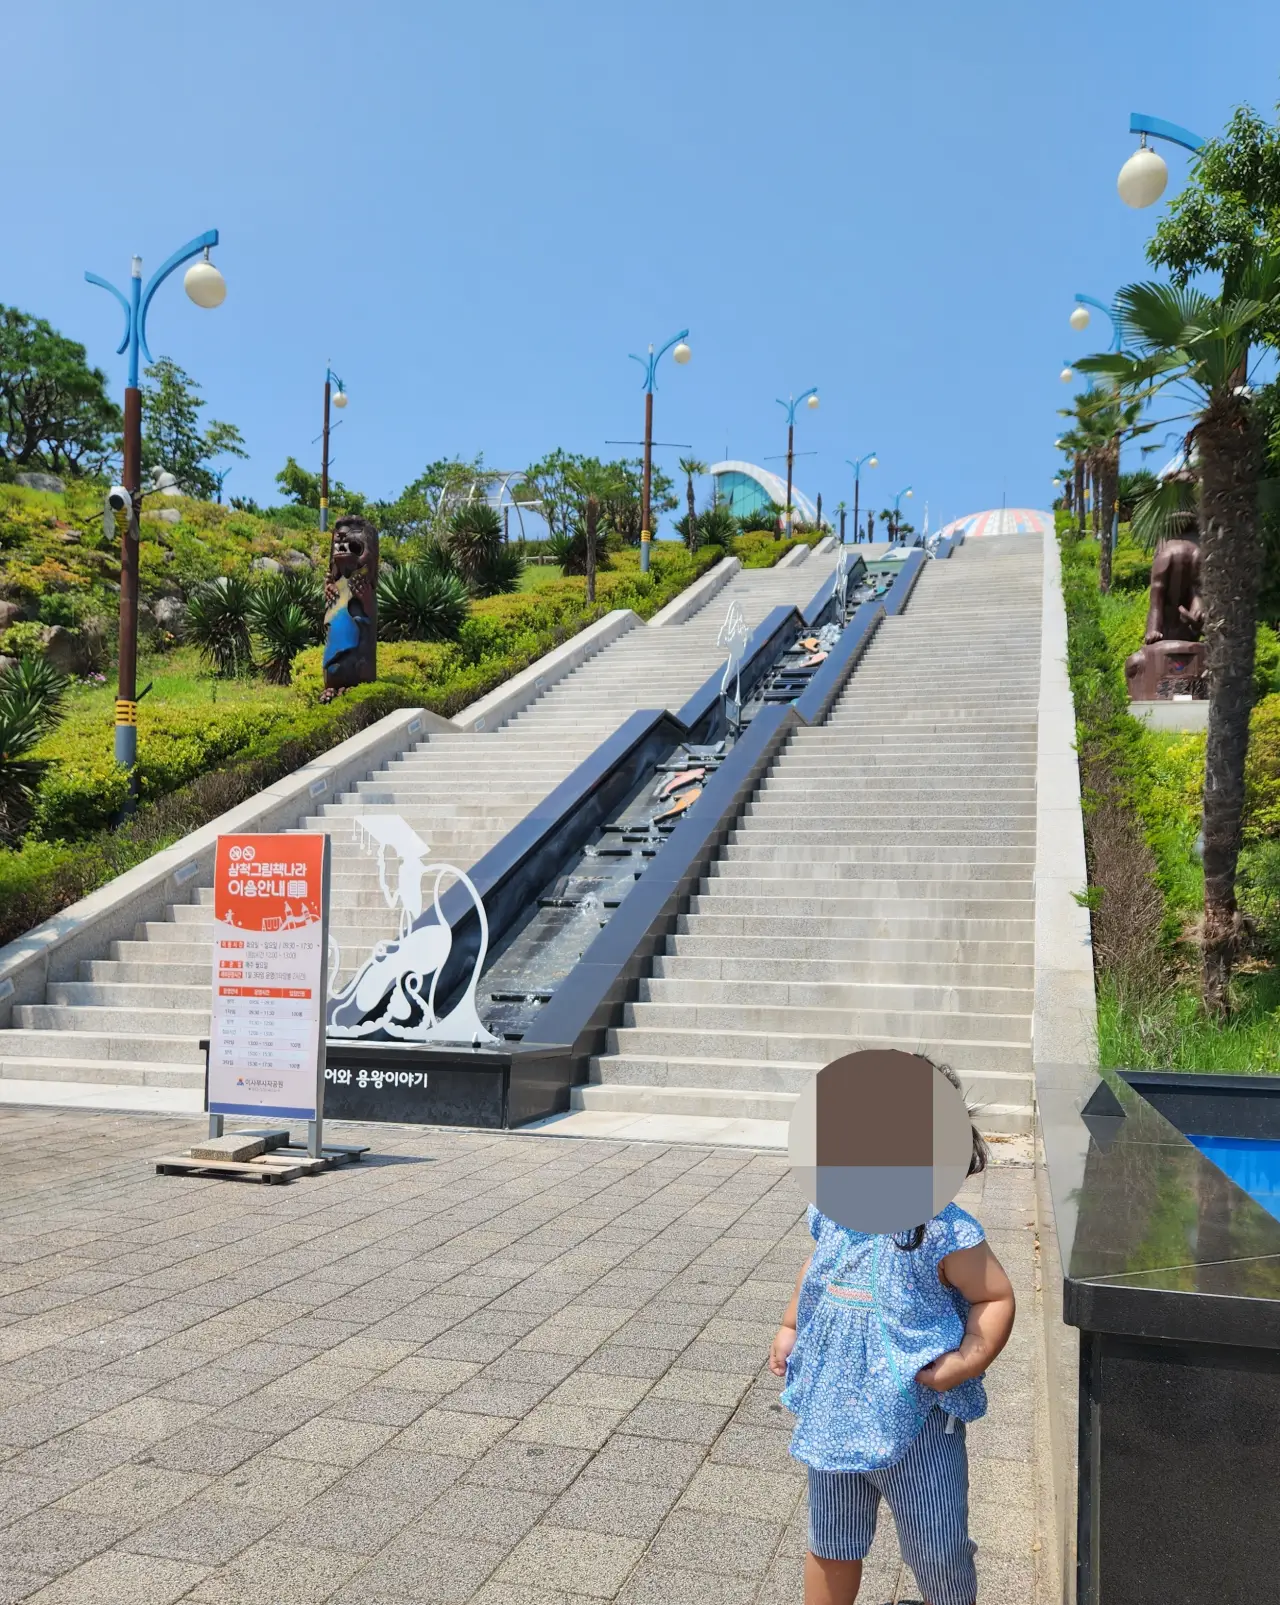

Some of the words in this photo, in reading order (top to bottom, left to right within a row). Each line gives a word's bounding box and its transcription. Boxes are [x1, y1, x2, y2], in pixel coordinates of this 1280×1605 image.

[228, 862, 307, 877] 삼척그림책나라
[228, 880, 285, 897] 이용안내
[356, 1070, 428, 1088] 용왕이야기
